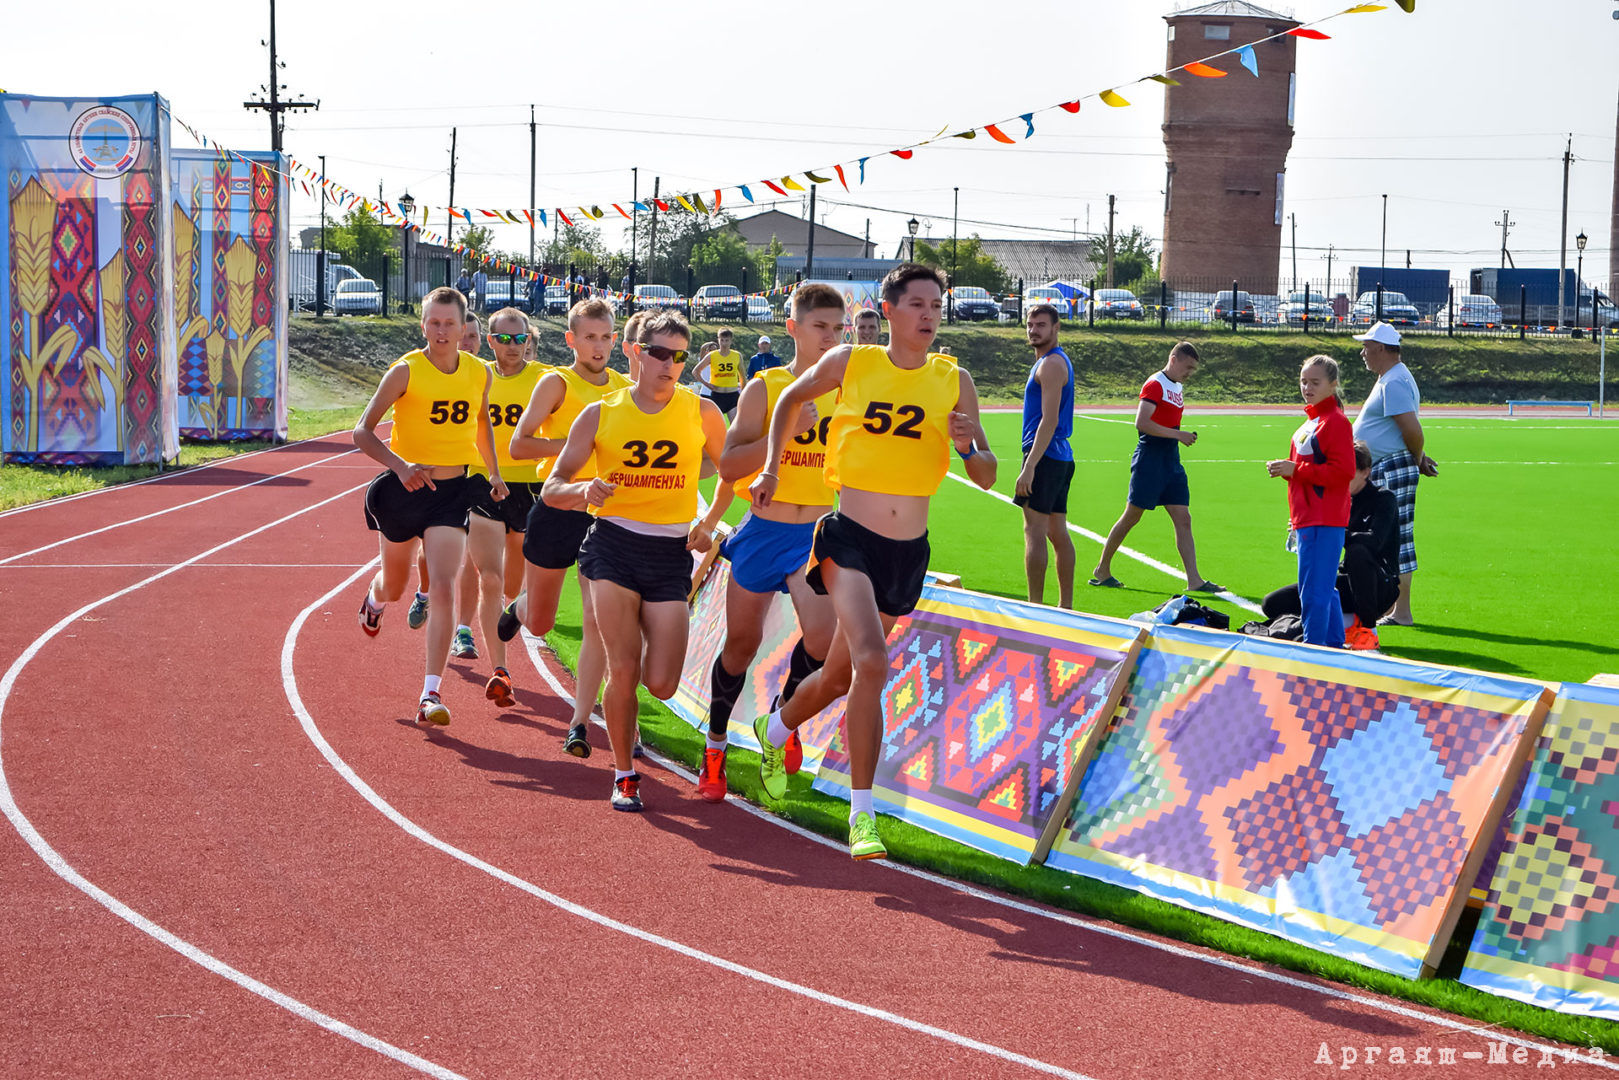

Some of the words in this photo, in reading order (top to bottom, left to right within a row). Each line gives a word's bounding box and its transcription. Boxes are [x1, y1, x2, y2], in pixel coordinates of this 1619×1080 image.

[718, 362, 733, 372] 35
[429, 400, 470, 425] 58
[488, 403, 524, 427] 38
[862, 401, 926, 440] 52
[622, 439, 679, 469] 32
